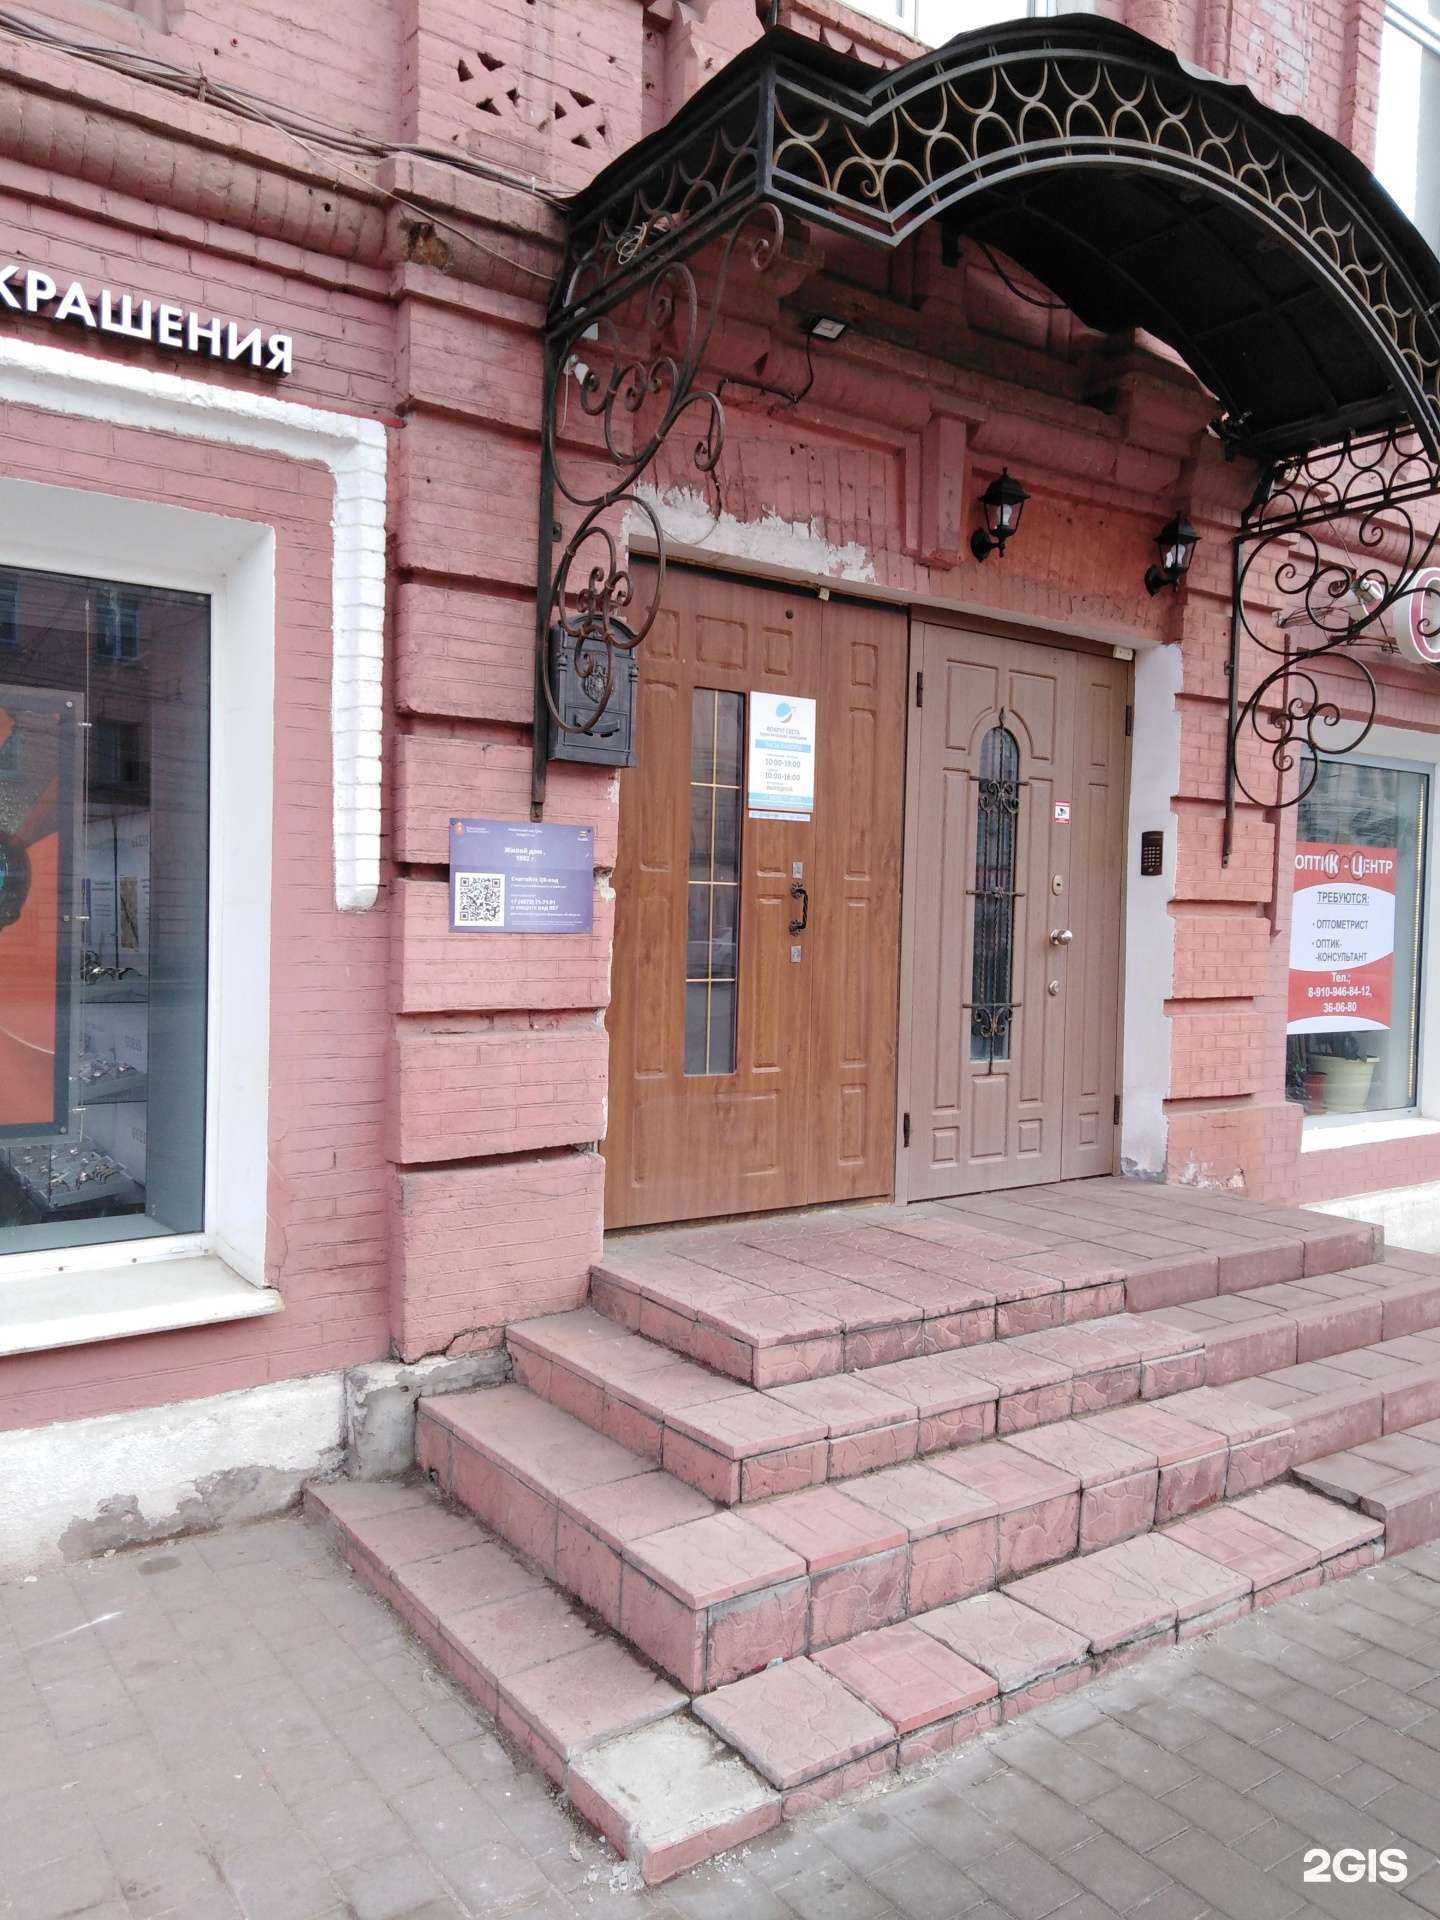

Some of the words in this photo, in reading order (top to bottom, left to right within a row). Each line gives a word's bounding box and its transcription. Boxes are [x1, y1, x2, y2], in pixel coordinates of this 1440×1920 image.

[1316, 891, 1370, 904] ТРЕБУЮТСЯ:
[1316, 919, 1369, 930] ОПТОМЕТРИСТ
[1315, 952, 1369, 962] -КОНСУЛЬТАНТ
